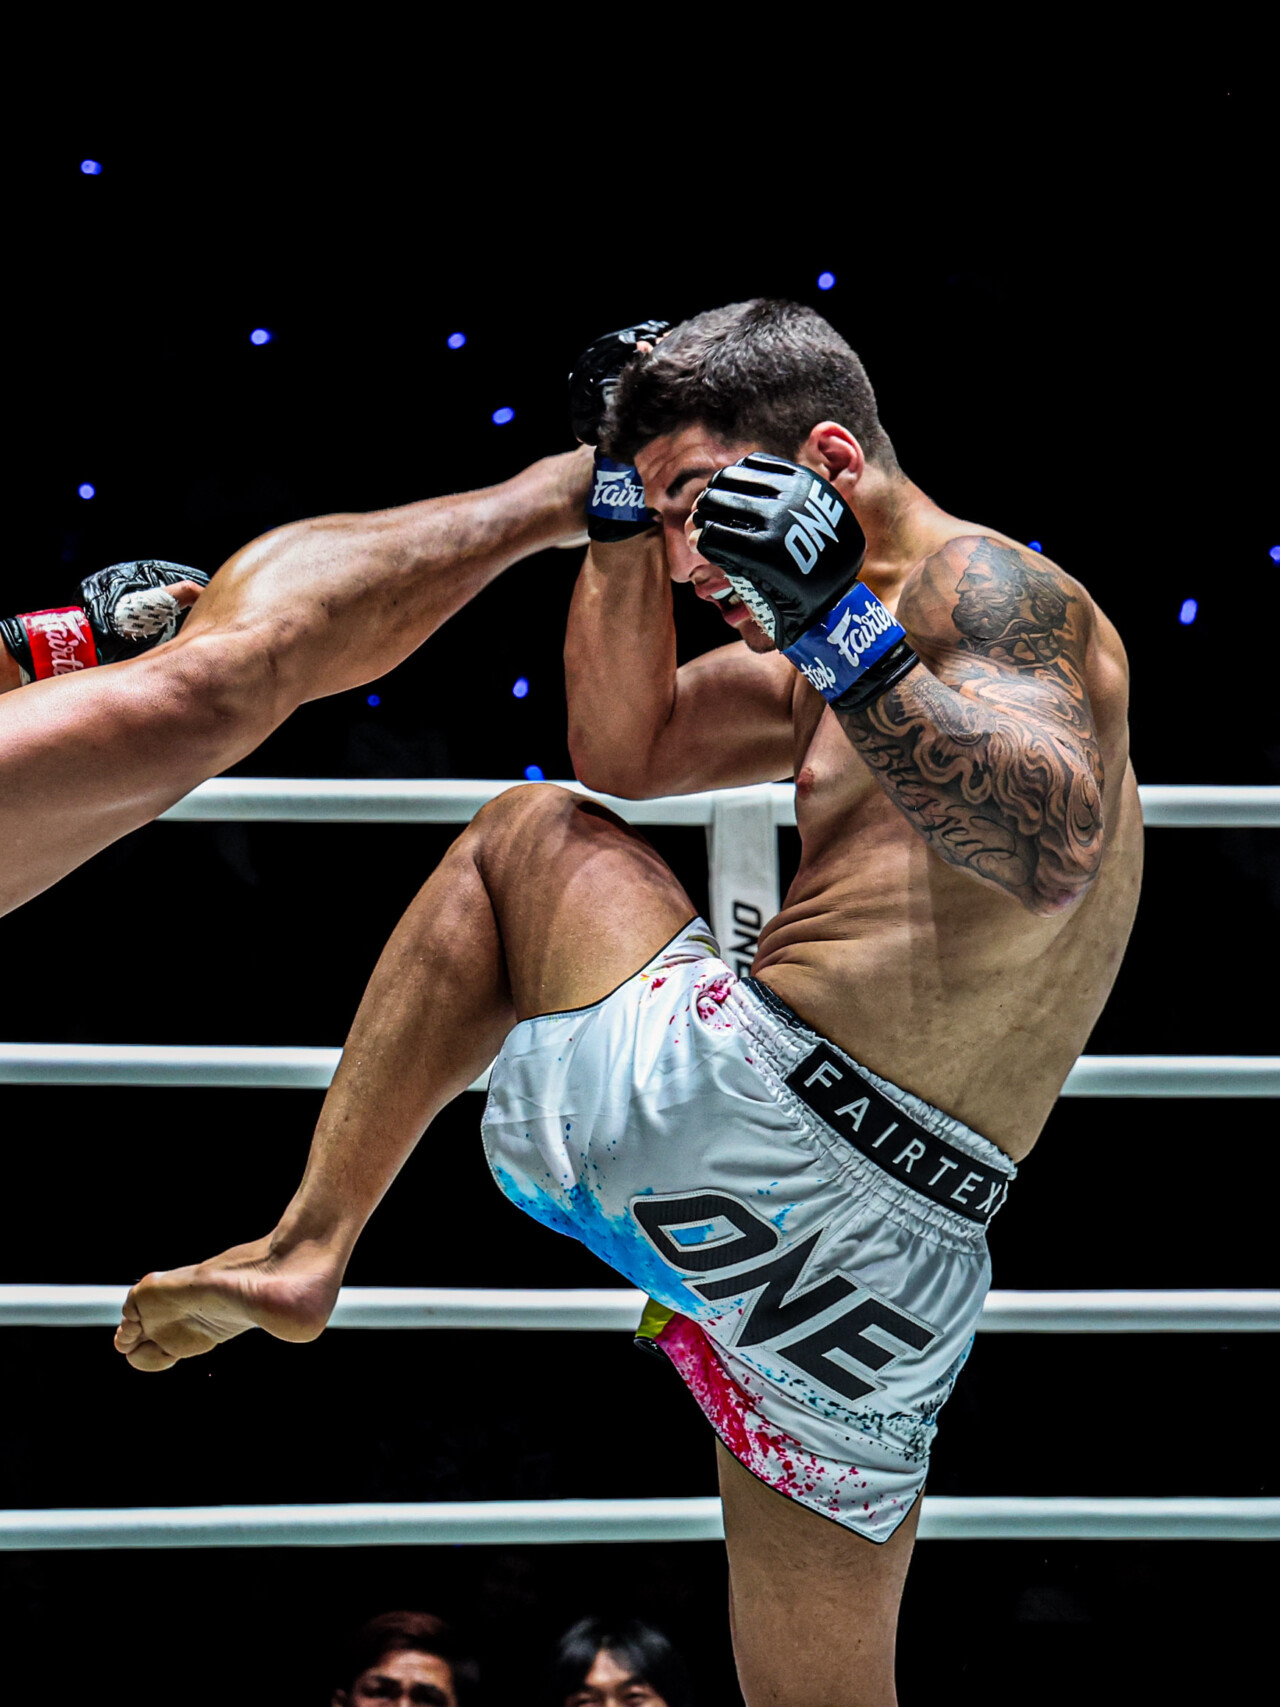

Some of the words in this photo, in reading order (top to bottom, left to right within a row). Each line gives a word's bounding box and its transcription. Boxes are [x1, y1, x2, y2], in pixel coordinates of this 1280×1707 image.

[591, 470, 646, 509] Fairt
[785, 480, 844, 575] ONE
[804, 1061, 1003, 1214] FAIRTEX
[630, 1189, 941, 1402] ONE
